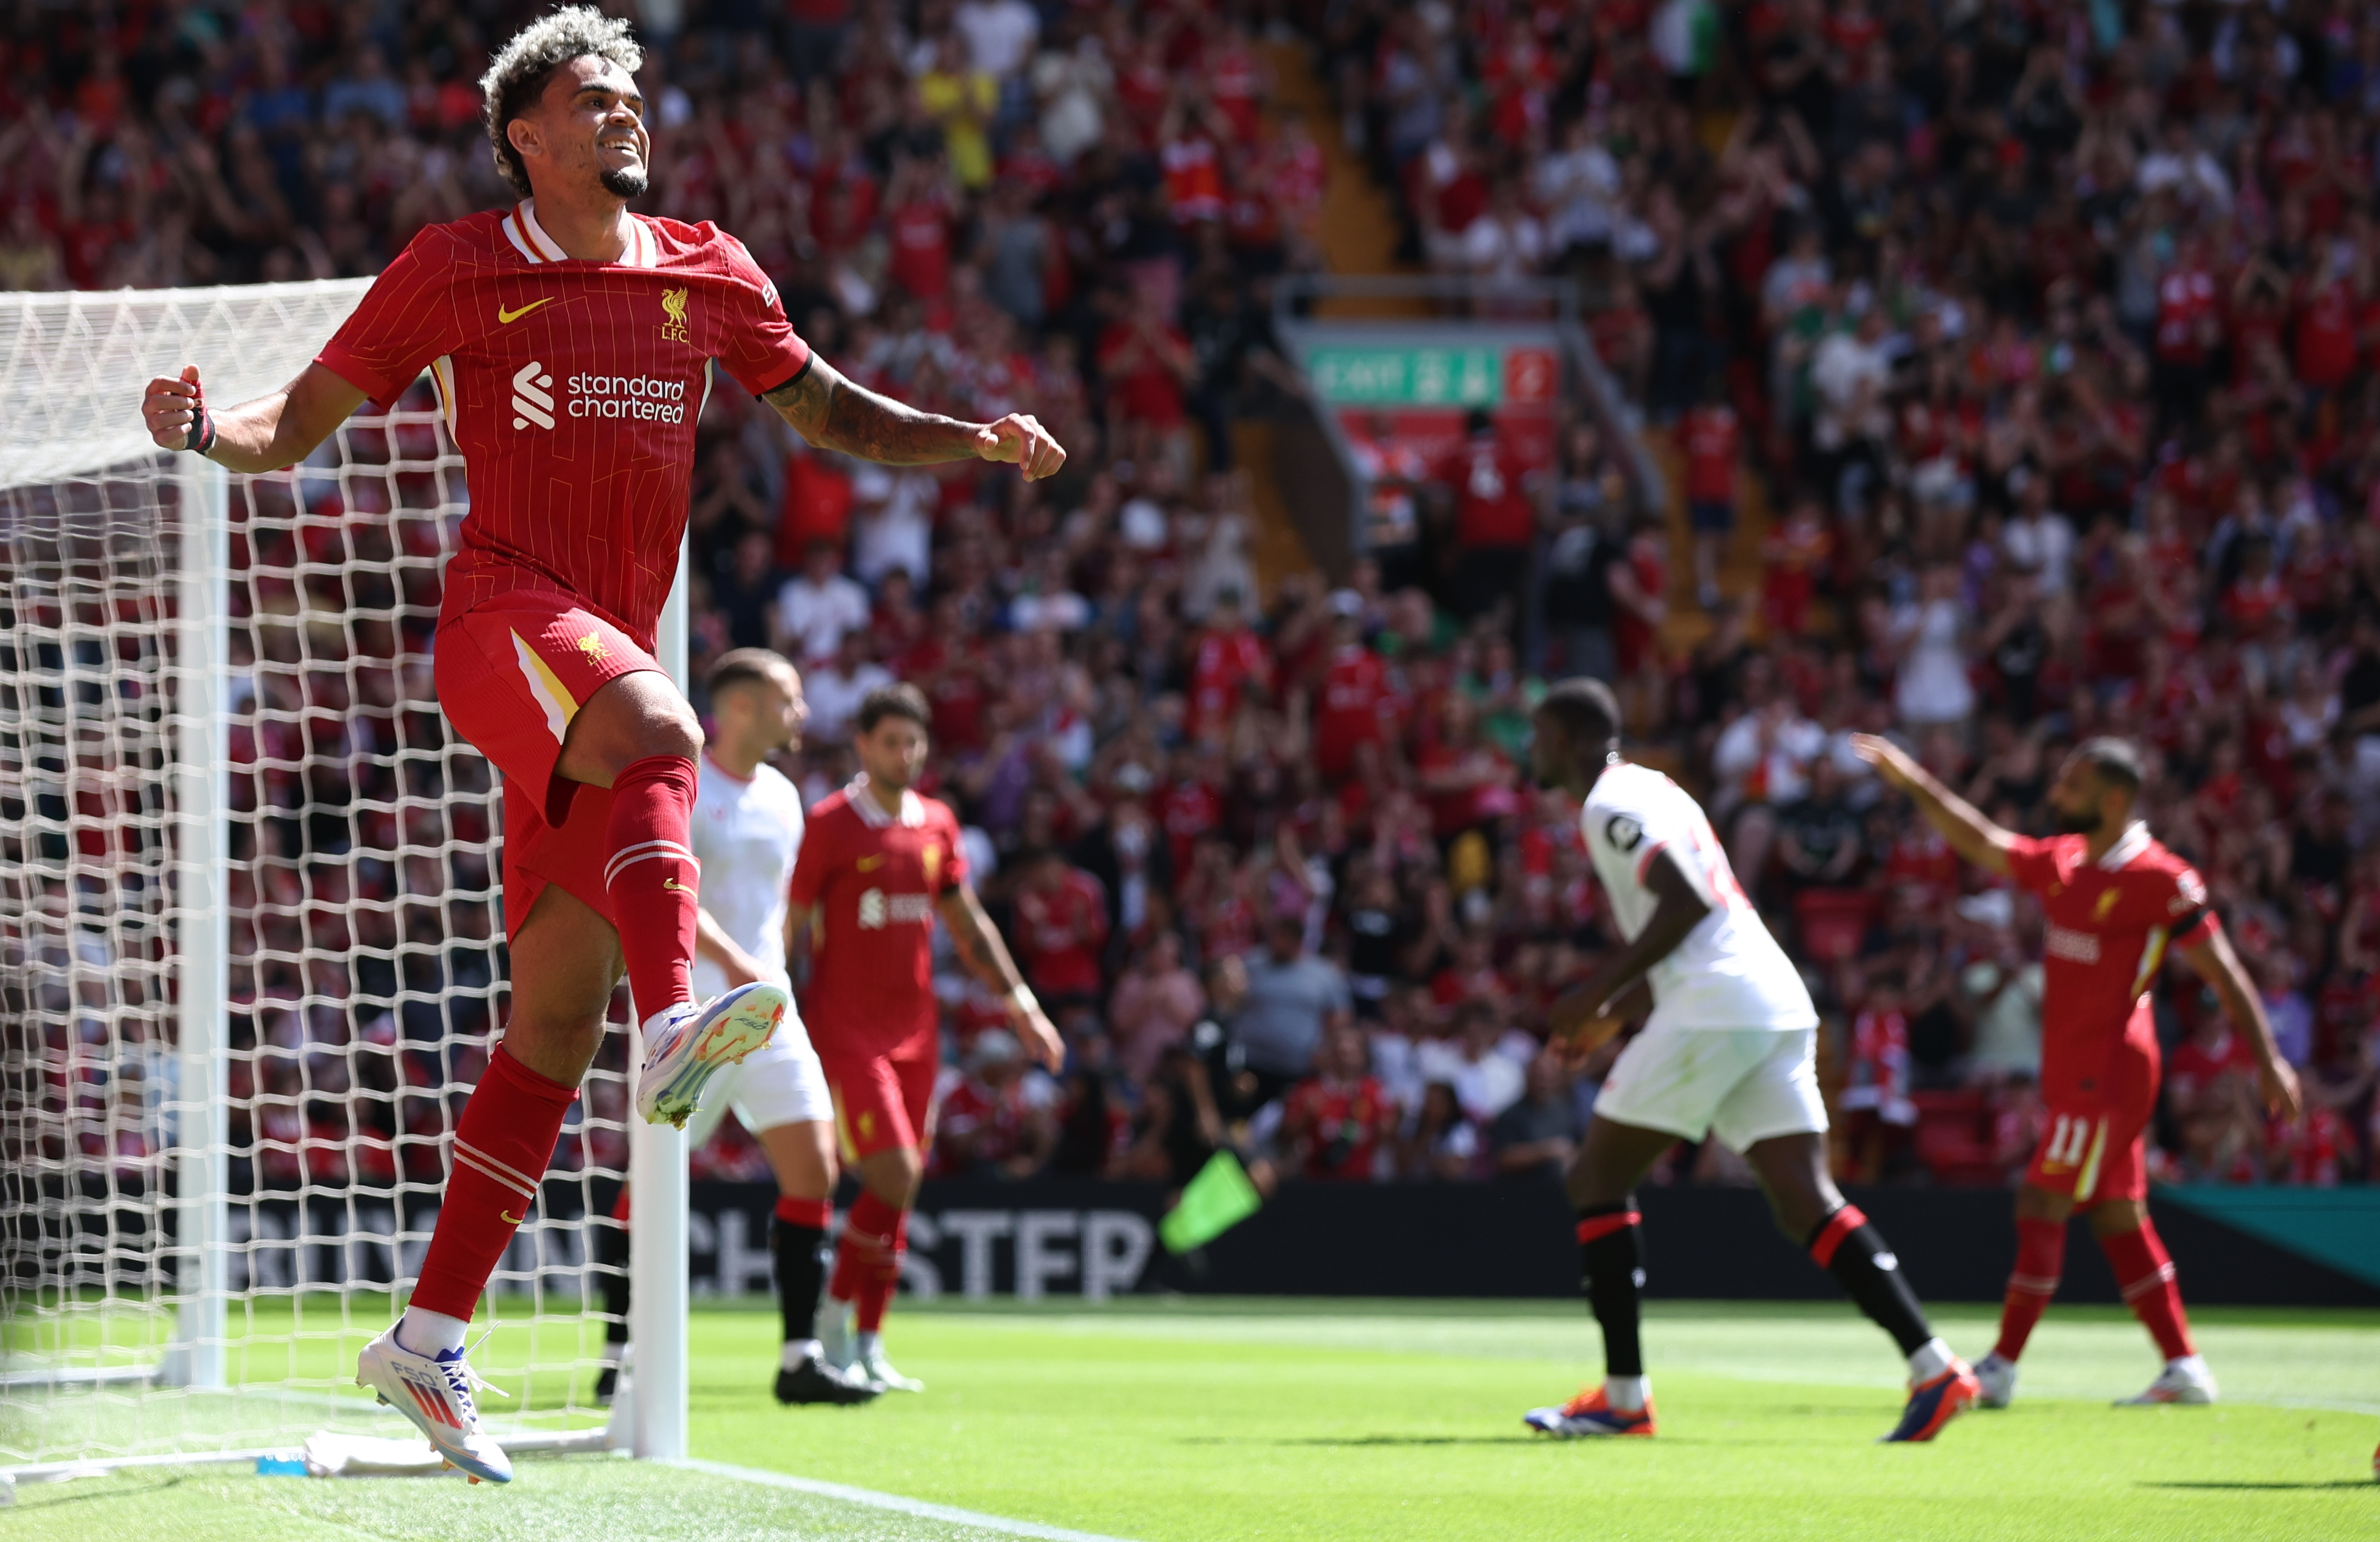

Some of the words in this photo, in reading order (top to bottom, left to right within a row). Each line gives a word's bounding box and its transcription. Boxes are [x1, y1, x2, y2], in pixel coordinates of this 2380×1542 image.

[568, 371, 685, 401] standard
[568, 395, 684, 424] chartered
[2047, 1113, 2088, 1165] 11
